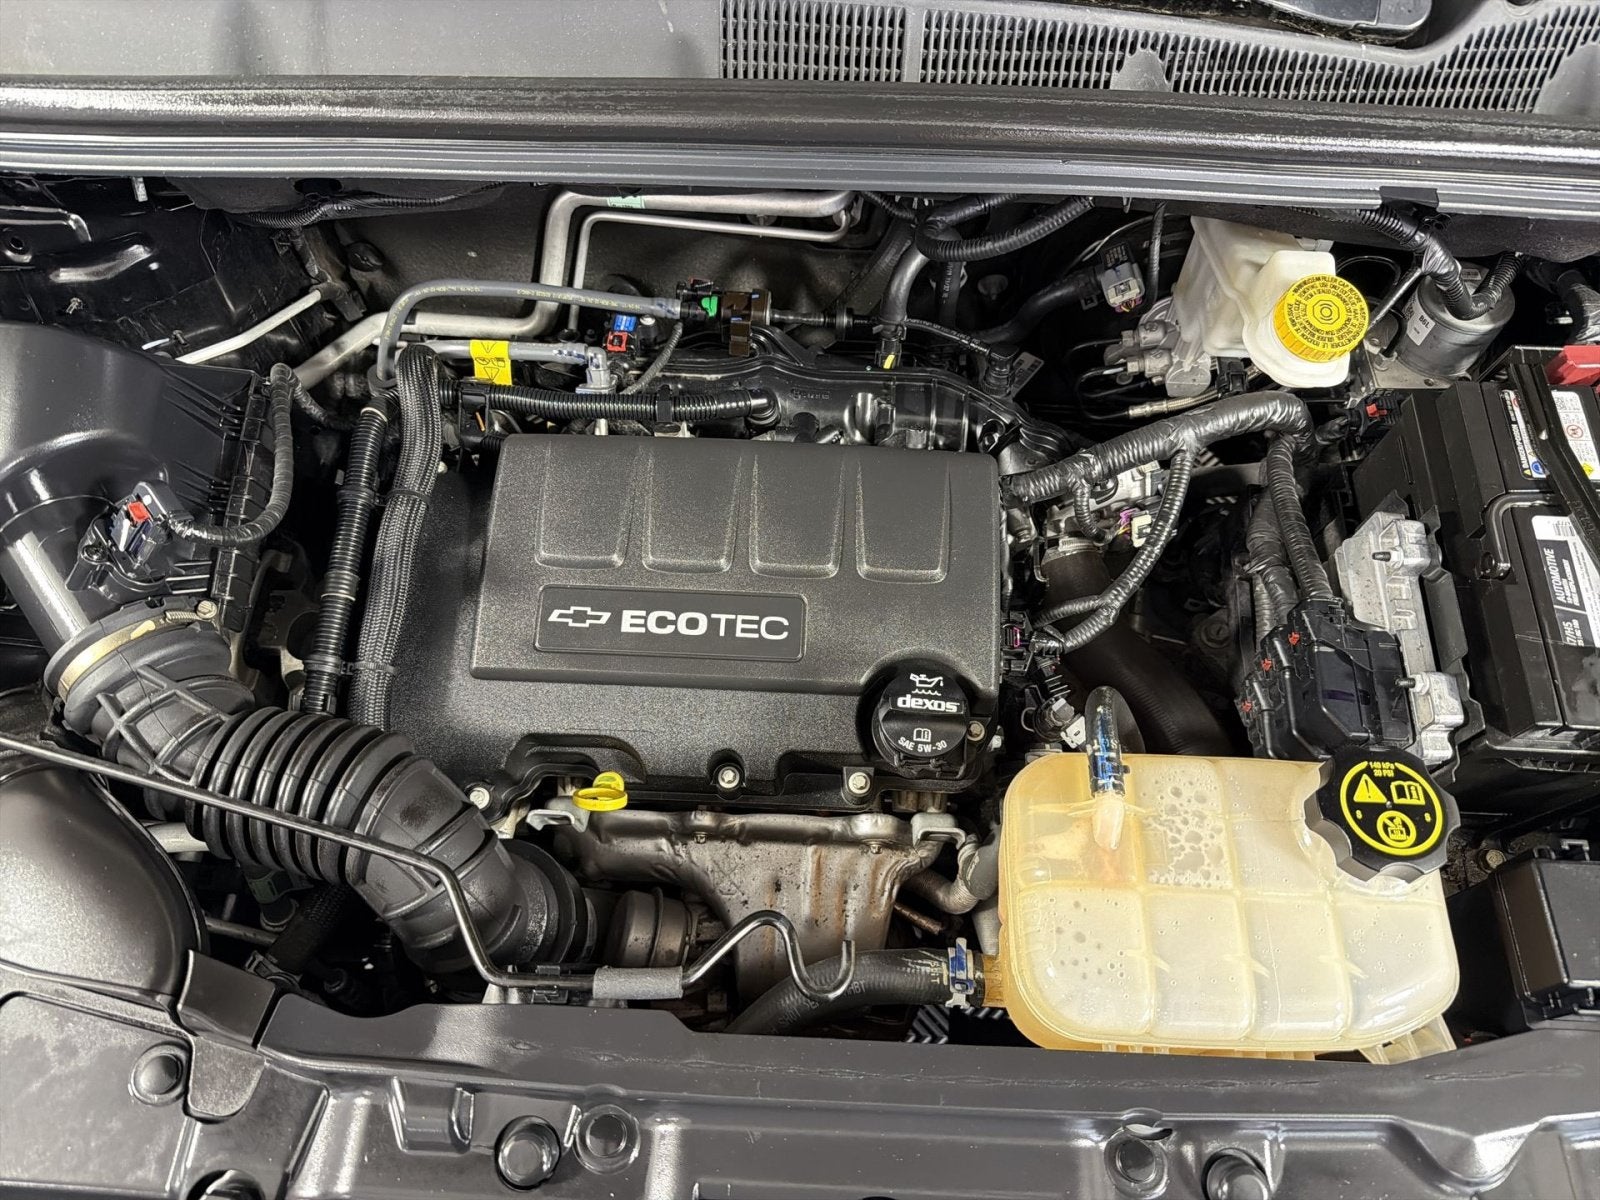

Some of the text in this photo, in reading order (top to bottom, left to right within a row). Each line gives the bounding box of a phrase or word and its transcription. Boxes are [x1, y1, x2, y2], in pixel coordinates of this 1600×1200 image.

[1543, 547, 1567, 603] AUTOMOTIVE
[620, 599, 790, 640] ECOTEC
[897, 694, 961, 713] dexos
[898, 736, 948, 753] SAE 5W-30
